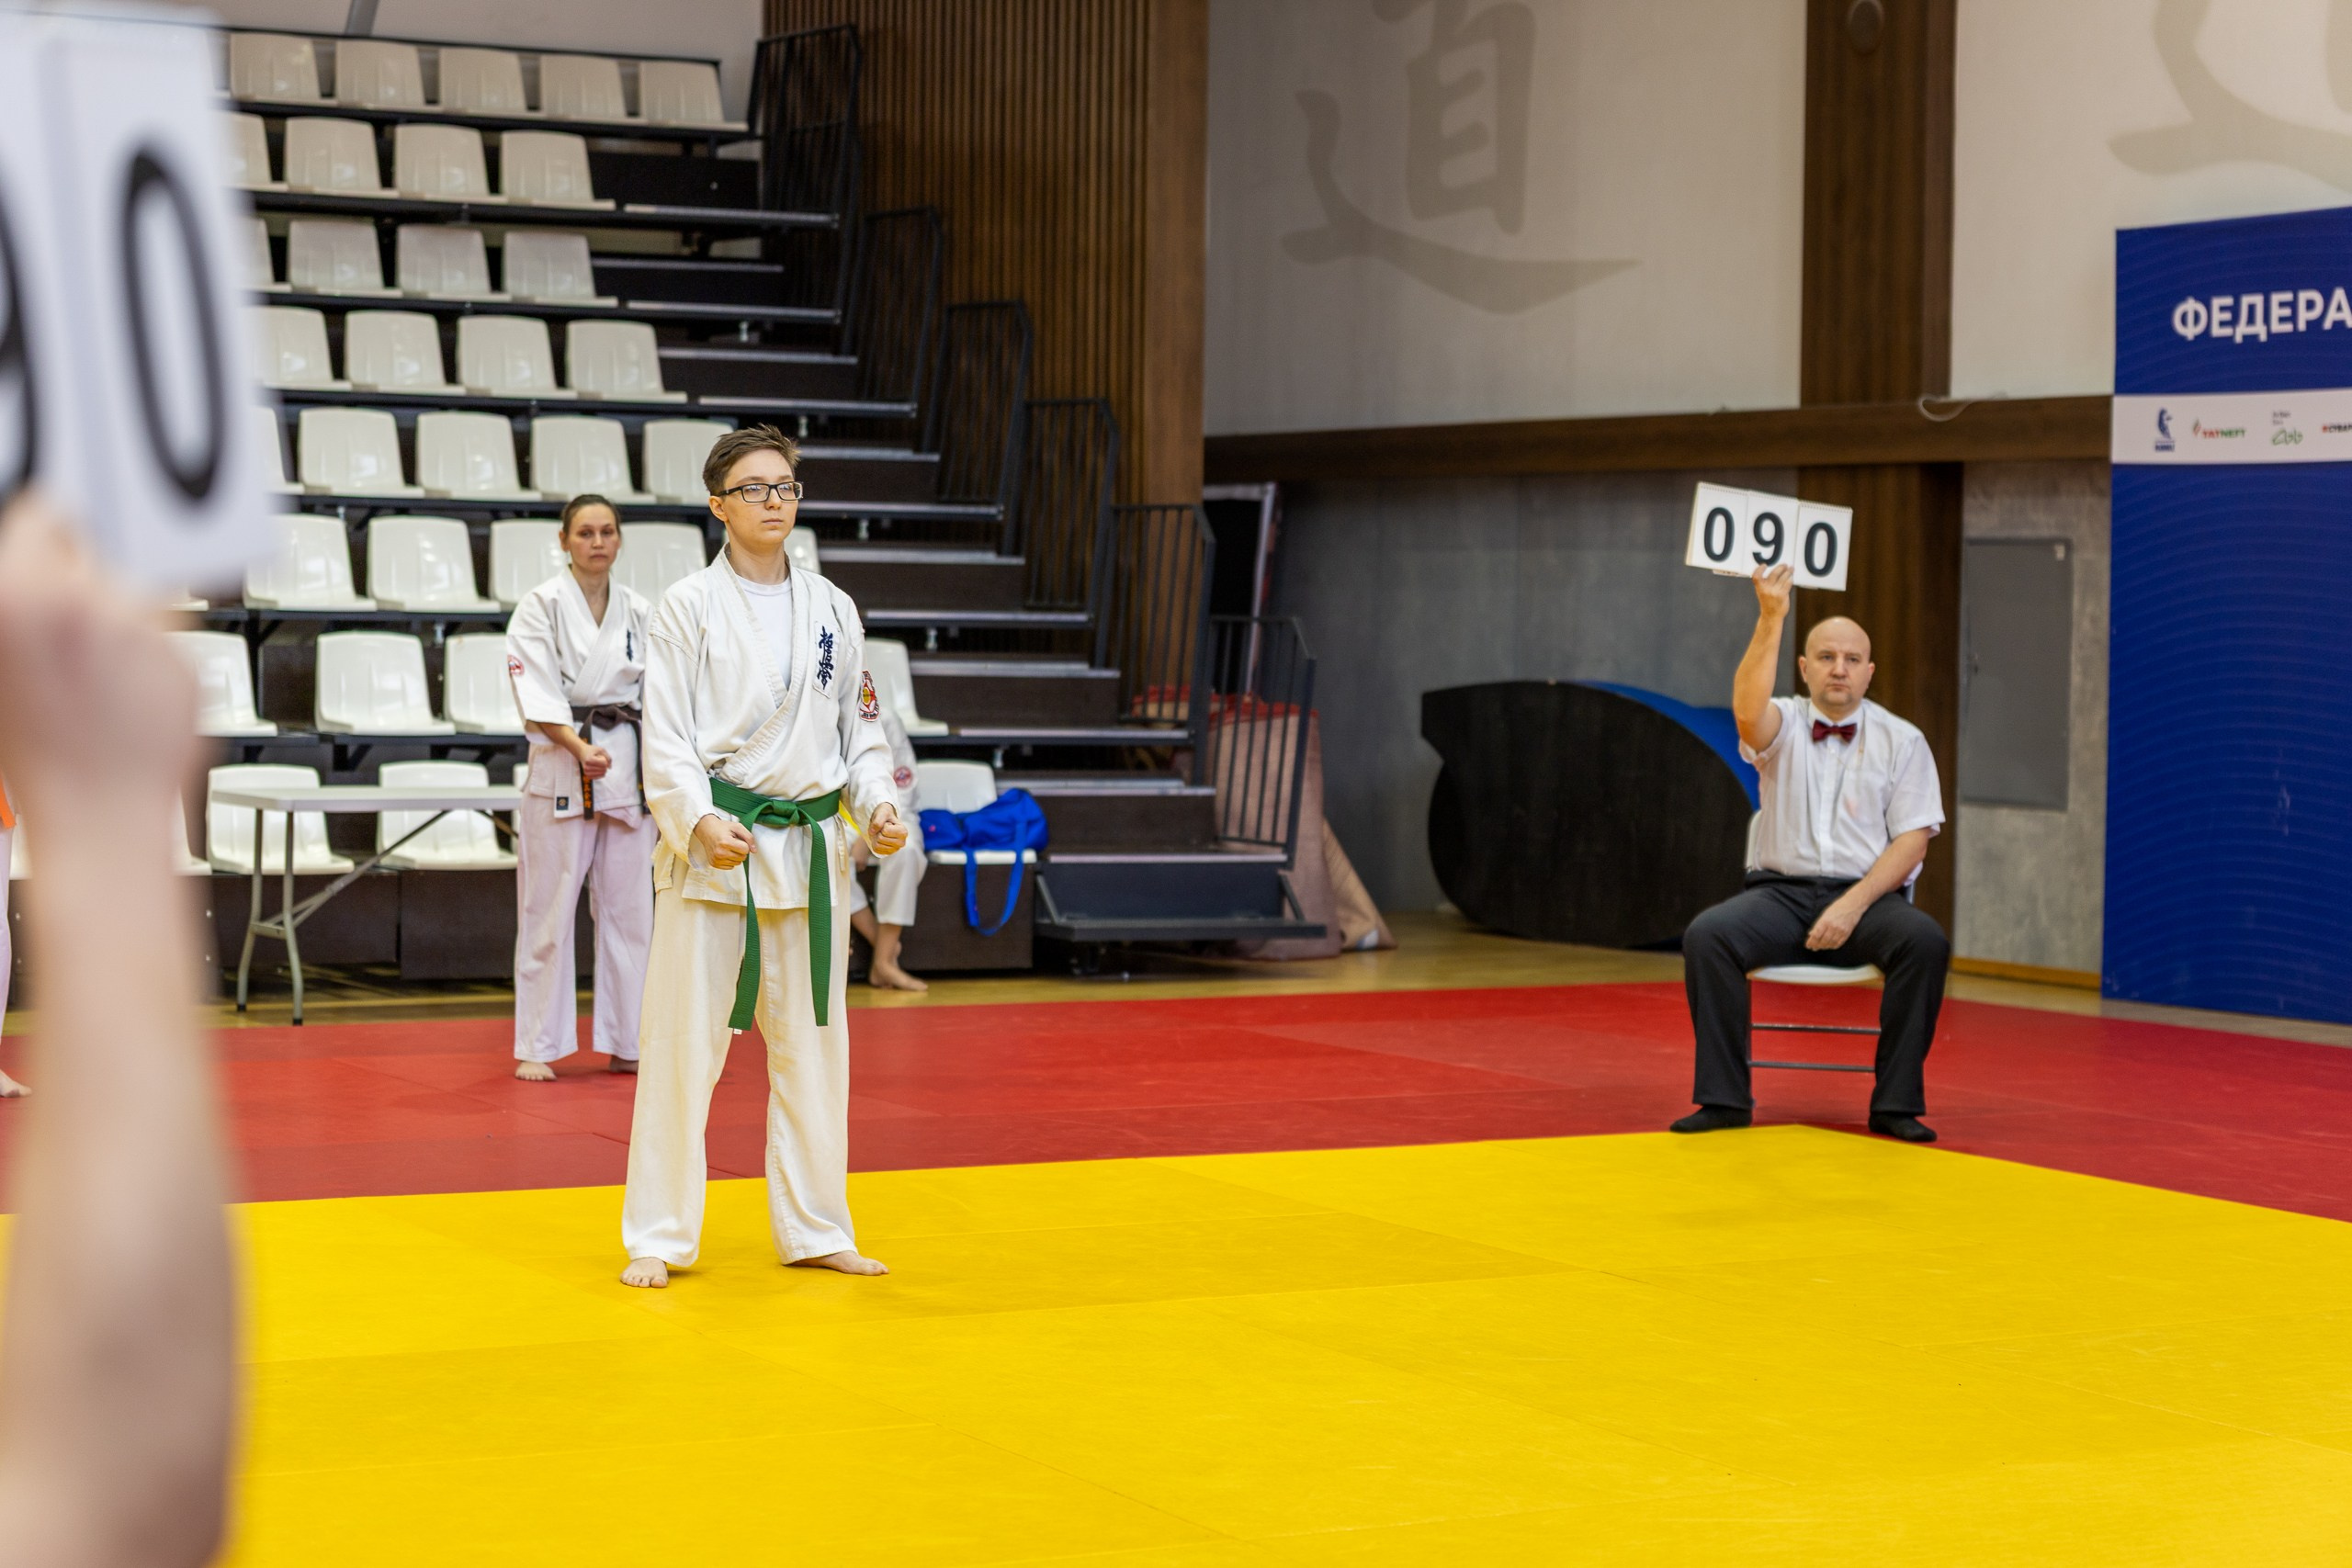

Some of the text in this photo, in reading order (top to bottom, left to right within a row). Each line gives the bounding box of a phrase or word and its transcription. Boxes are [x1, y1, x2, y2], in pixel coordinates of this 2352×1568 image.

[2171, 287, 2352, 344] ФЕДЕРА
[2201, 428, 2246, 439] TATNEFT
[1703, 506, 1838, 578] 090
